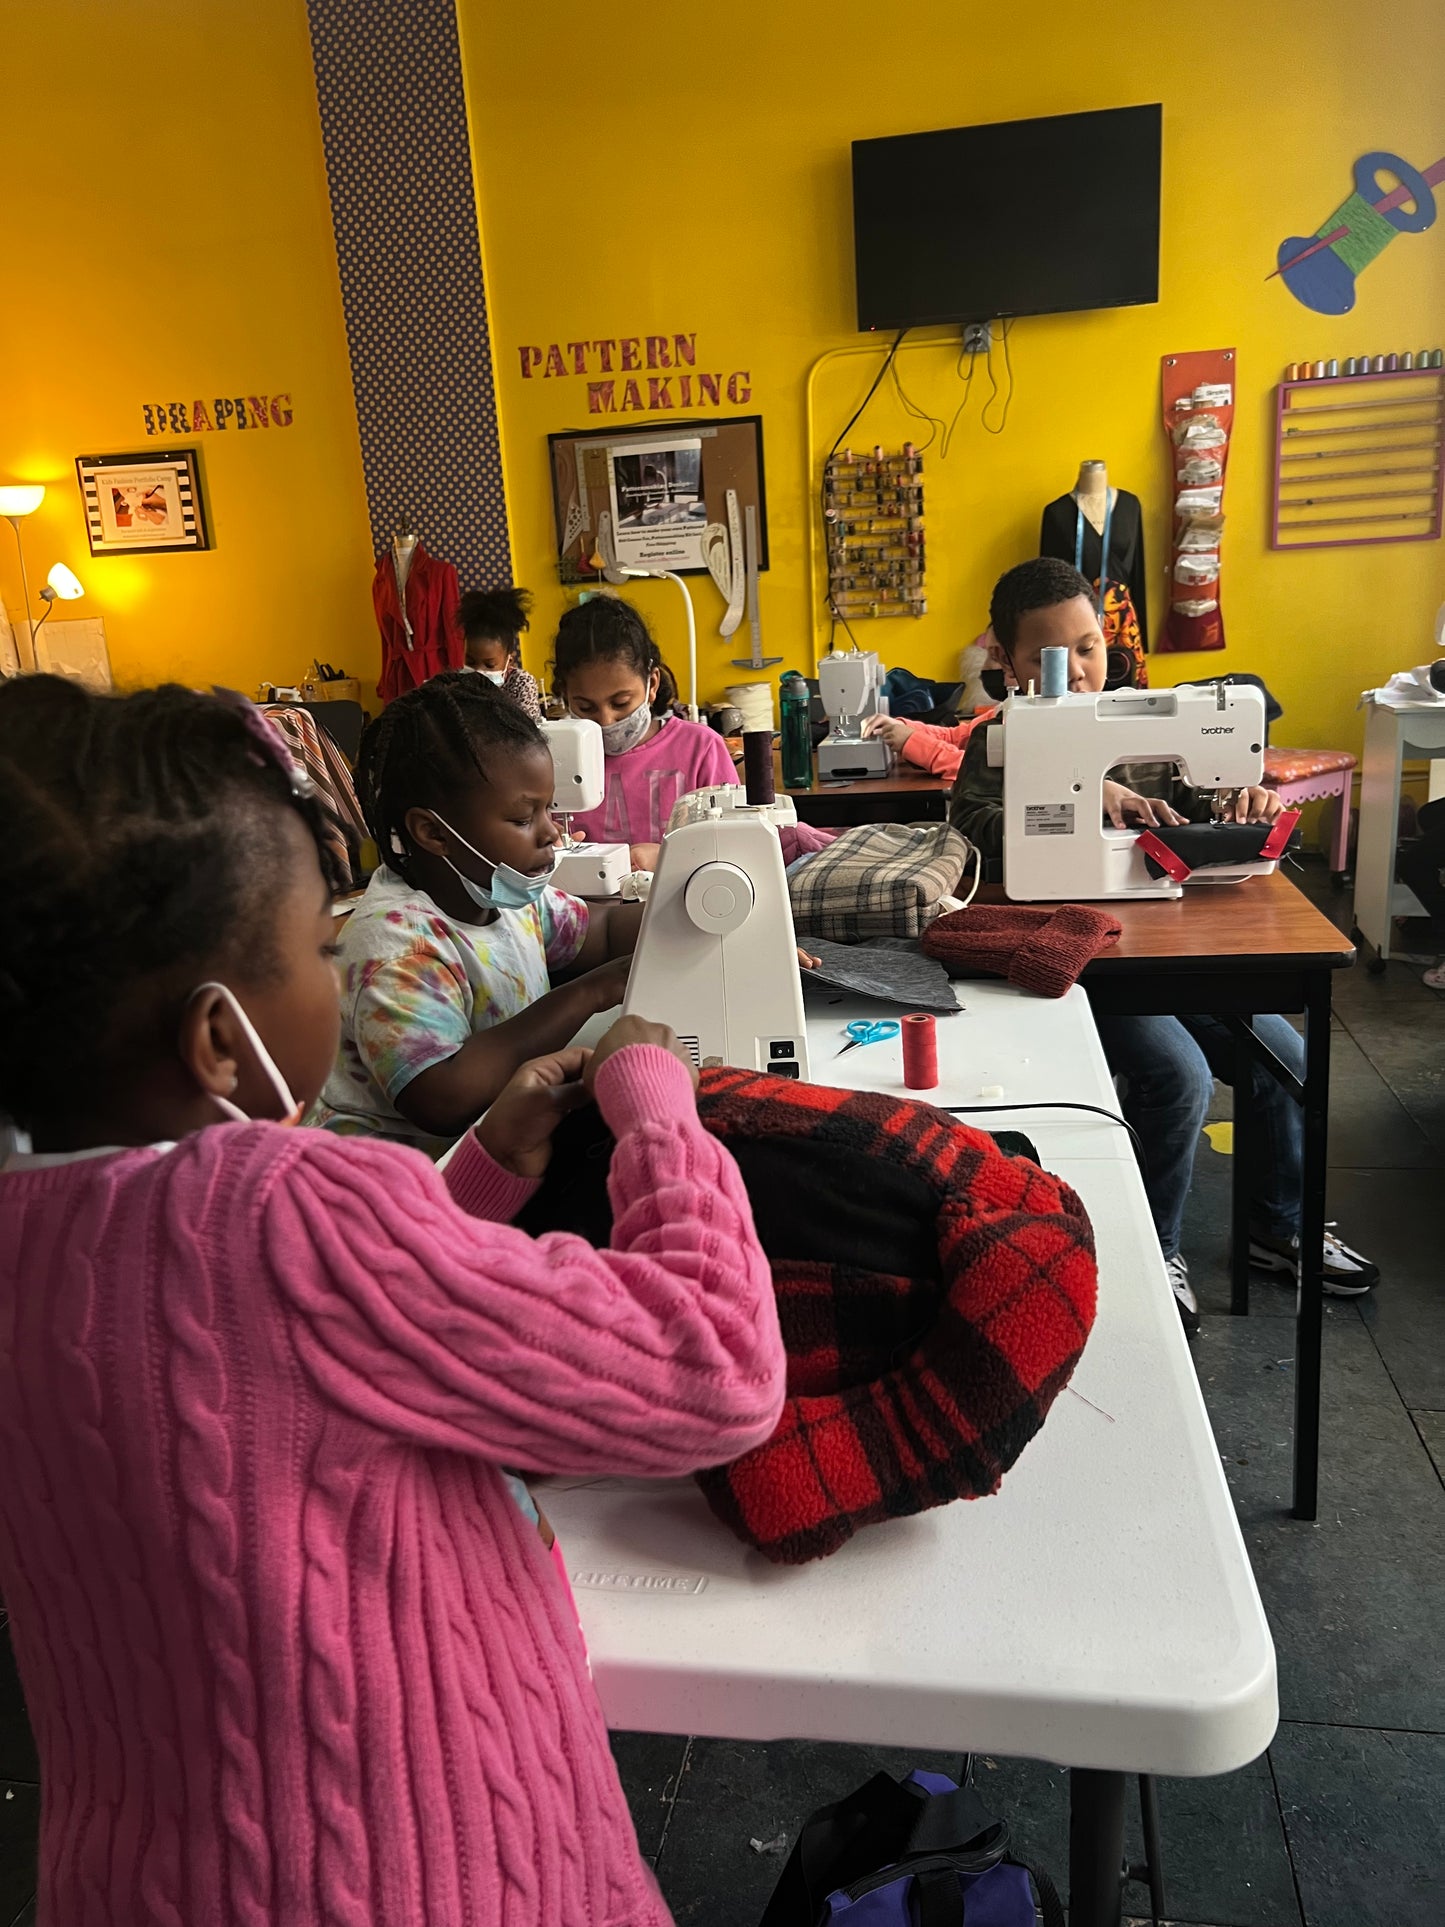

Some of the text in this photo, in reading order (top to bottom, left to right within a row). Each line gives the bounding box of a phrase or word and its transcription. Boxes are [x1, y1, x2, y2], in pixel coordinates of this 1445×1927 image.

[518, 333, 697, 379] PATTERN
[587, 370, 752, 414] MAKING
[142, 393, 293, 436] DRAPING
[1201, 727, 1235, 735] brother
